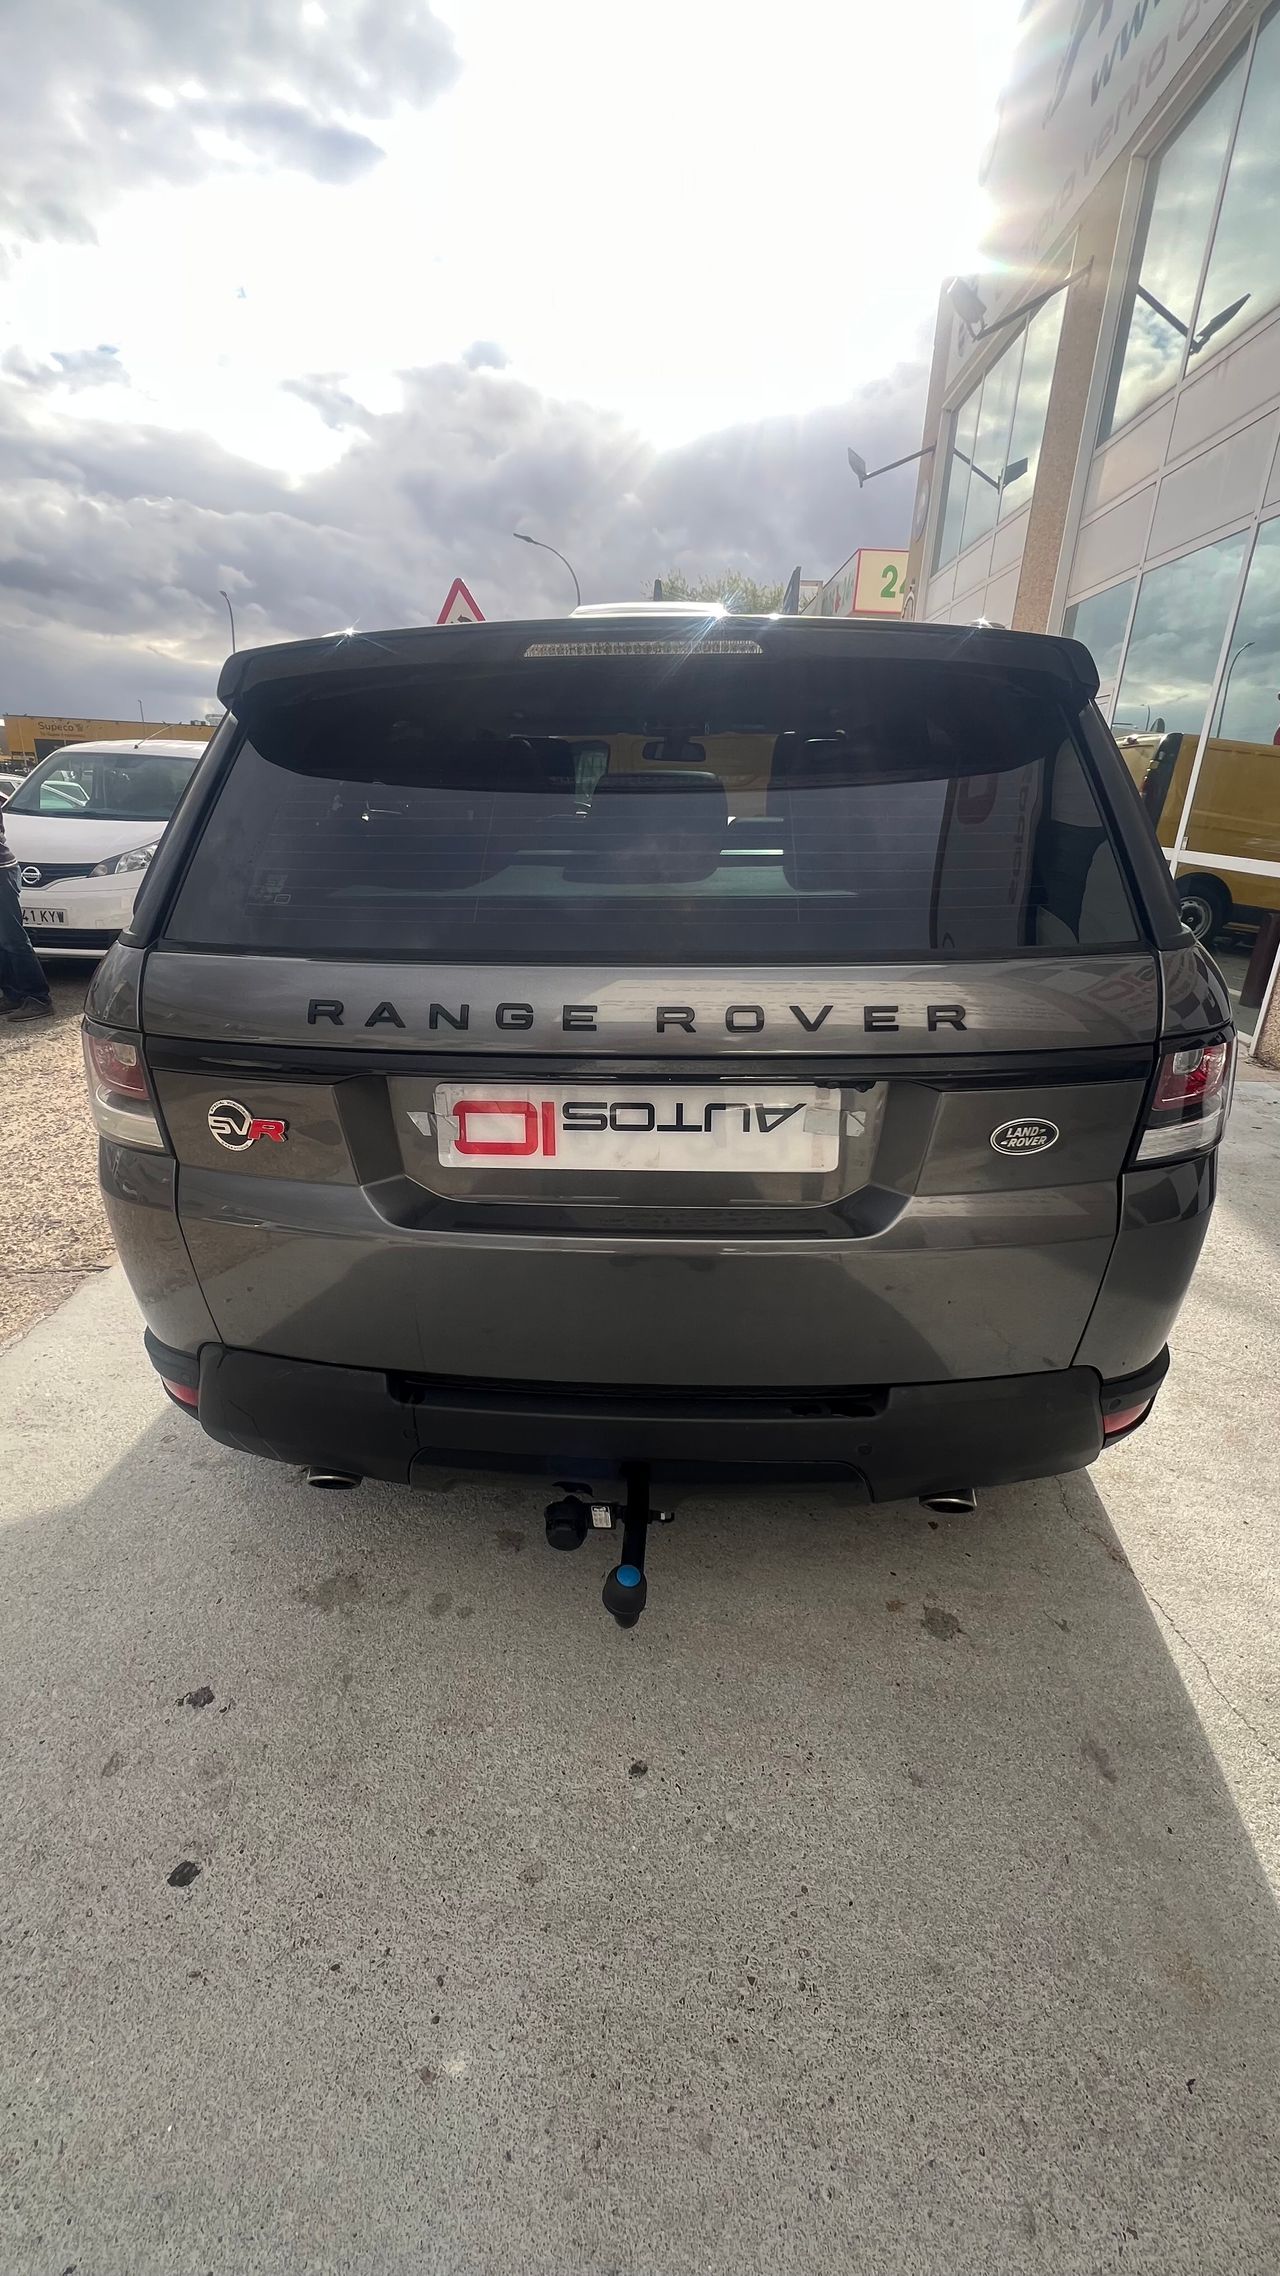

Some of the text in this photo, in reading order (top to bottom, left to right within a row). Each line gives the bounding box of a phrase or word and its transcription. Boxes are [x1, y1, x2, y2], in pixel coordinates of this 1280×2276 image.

[1090, 0, 1160, 107] ww
[38, 721, 74, 731] Supeco
[40, 910, 64, 923] KYW
[306, 998, 968, 1034] RANGE ROVER
[1006, 1126, 1039, 1138] LAND
[1007, 1136, 1047, 1147] ROVER
